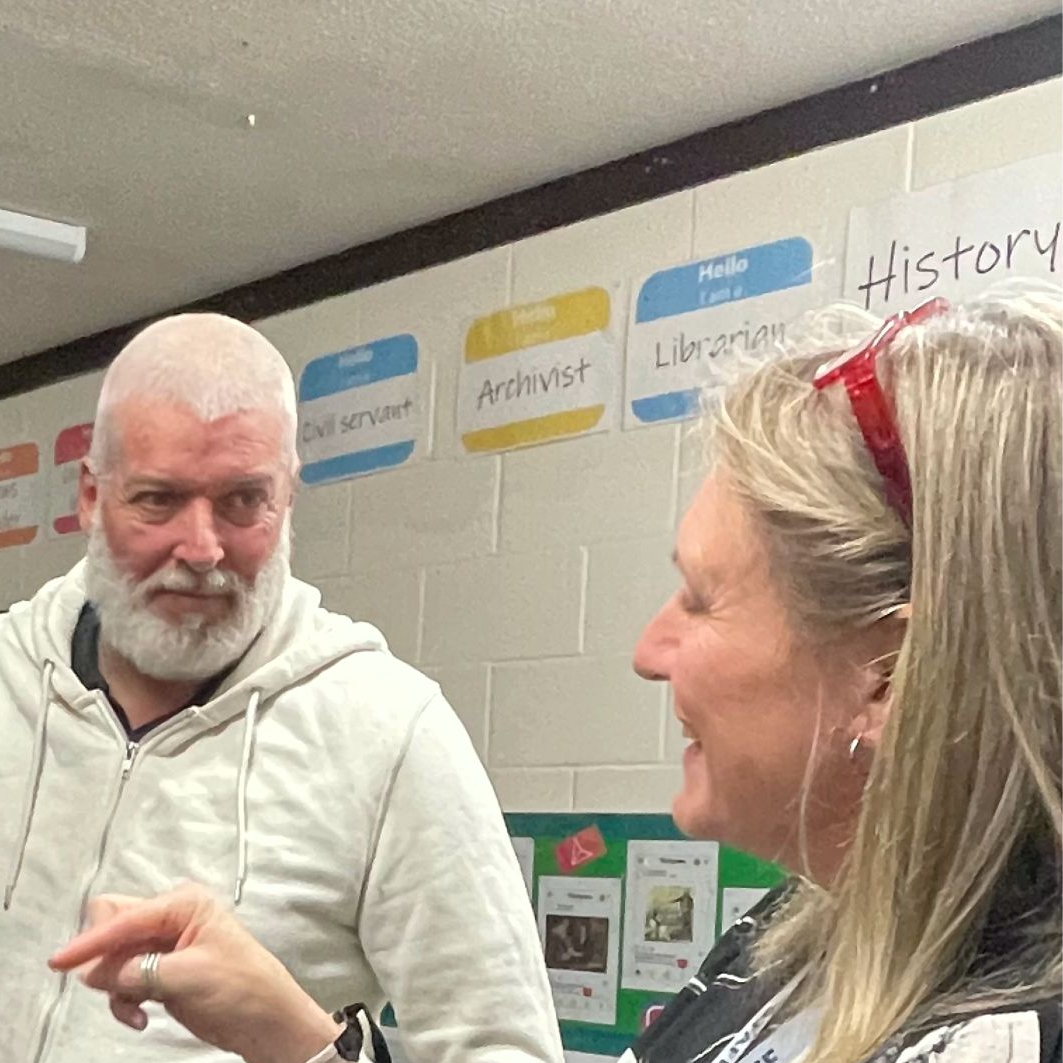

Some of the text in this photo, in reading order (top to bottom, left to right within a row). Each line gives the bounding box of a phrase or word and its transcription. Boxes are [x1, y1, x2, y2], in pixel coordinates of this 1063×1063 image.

[698, 255, 748, 283] Hello
[858, 222, 1062, 311] History
[655, 321, 786, 369] Librarian
[476, 357, 592, 411] Archivist
